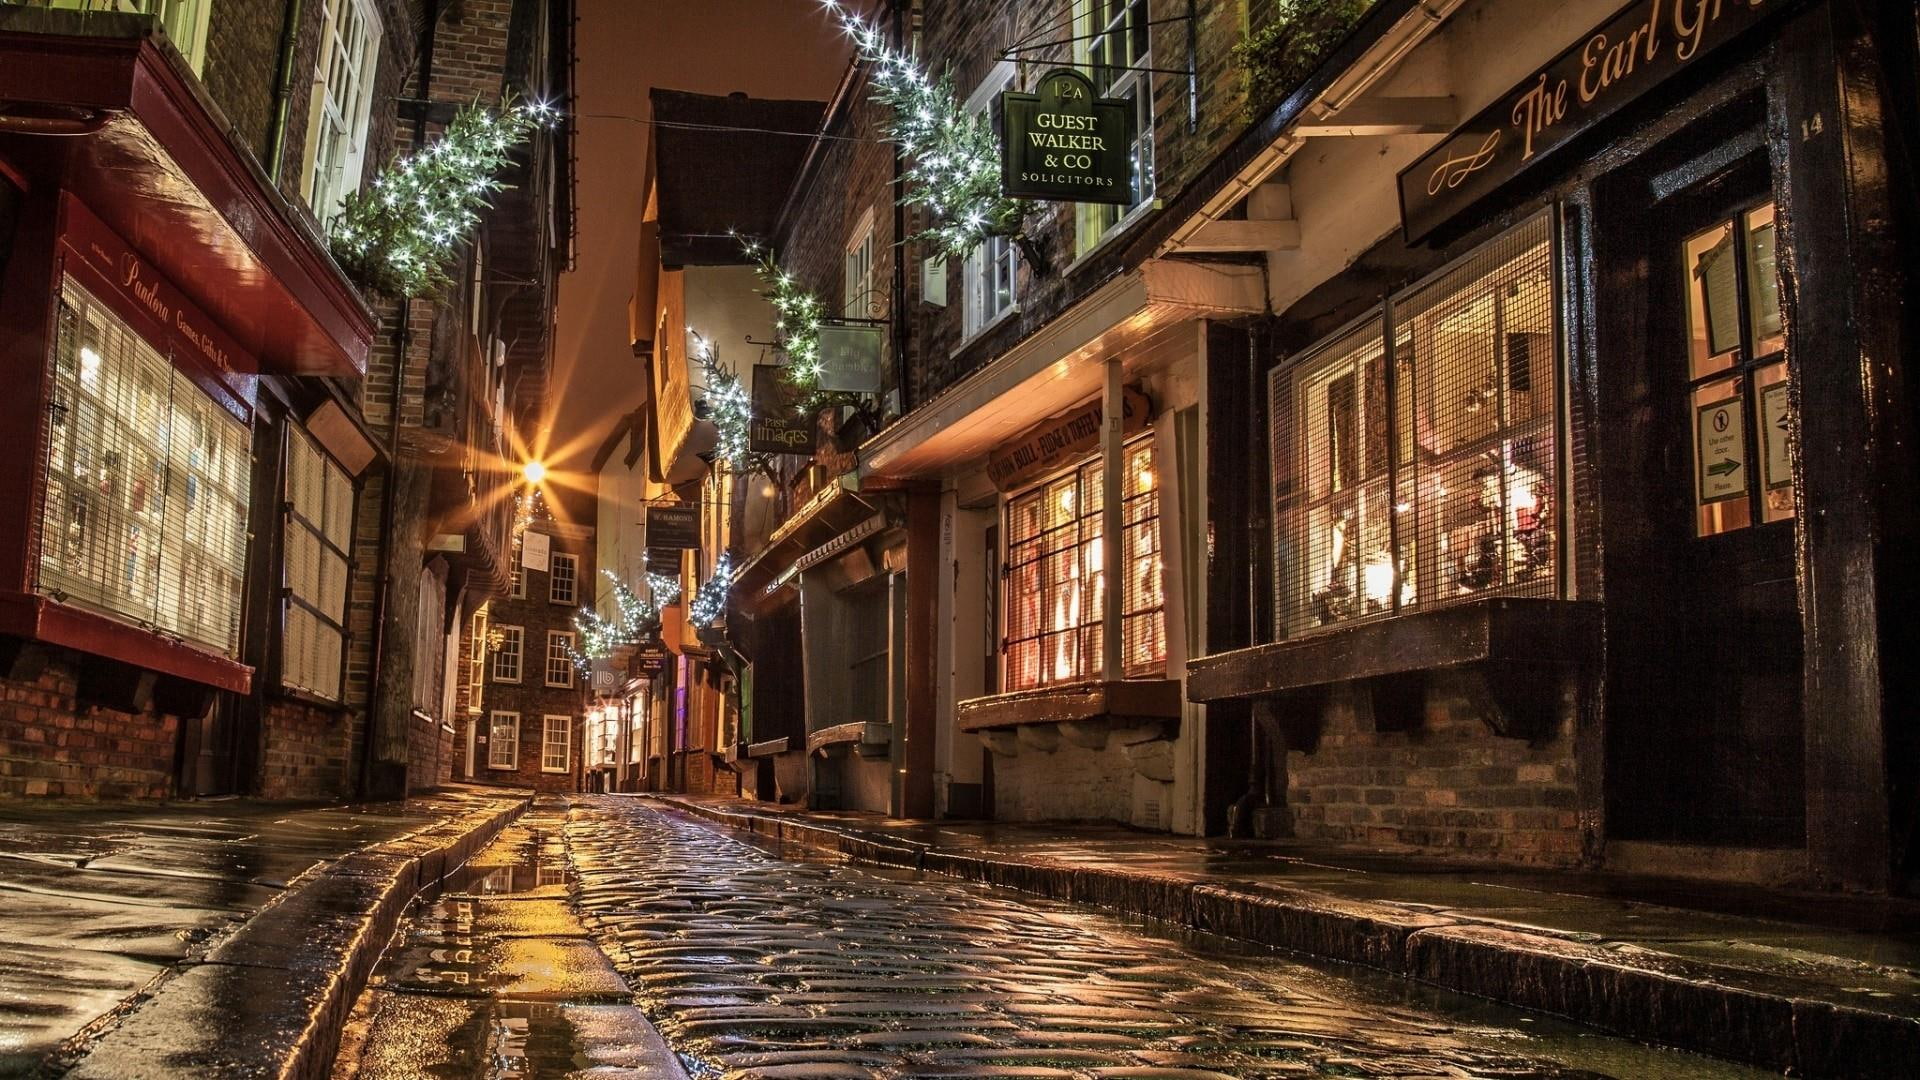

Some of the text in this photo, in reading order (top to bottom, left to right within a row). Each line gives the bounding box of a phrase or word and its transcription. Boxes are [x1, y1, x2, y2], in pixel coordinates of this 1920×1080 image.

[1054, 80, 1083, 99] 12A
[1511, 72, 1568, 161] The
[1579, 0, 1660, 102] Earl
[1037, 113, 1098, 131] GUEST
[1801, 112, 1824, 142] 14
[1028, 132, 1107, 151] WALKER
[1044, 153, 1092, 169] & CO
[1021, 172, 1113, 186] SOLICITORS
[120, 251, 169, 323] Pandora
[1013, 443, 1039, 470] BULL
[1039, 428, 1065, 457] FUDGE
